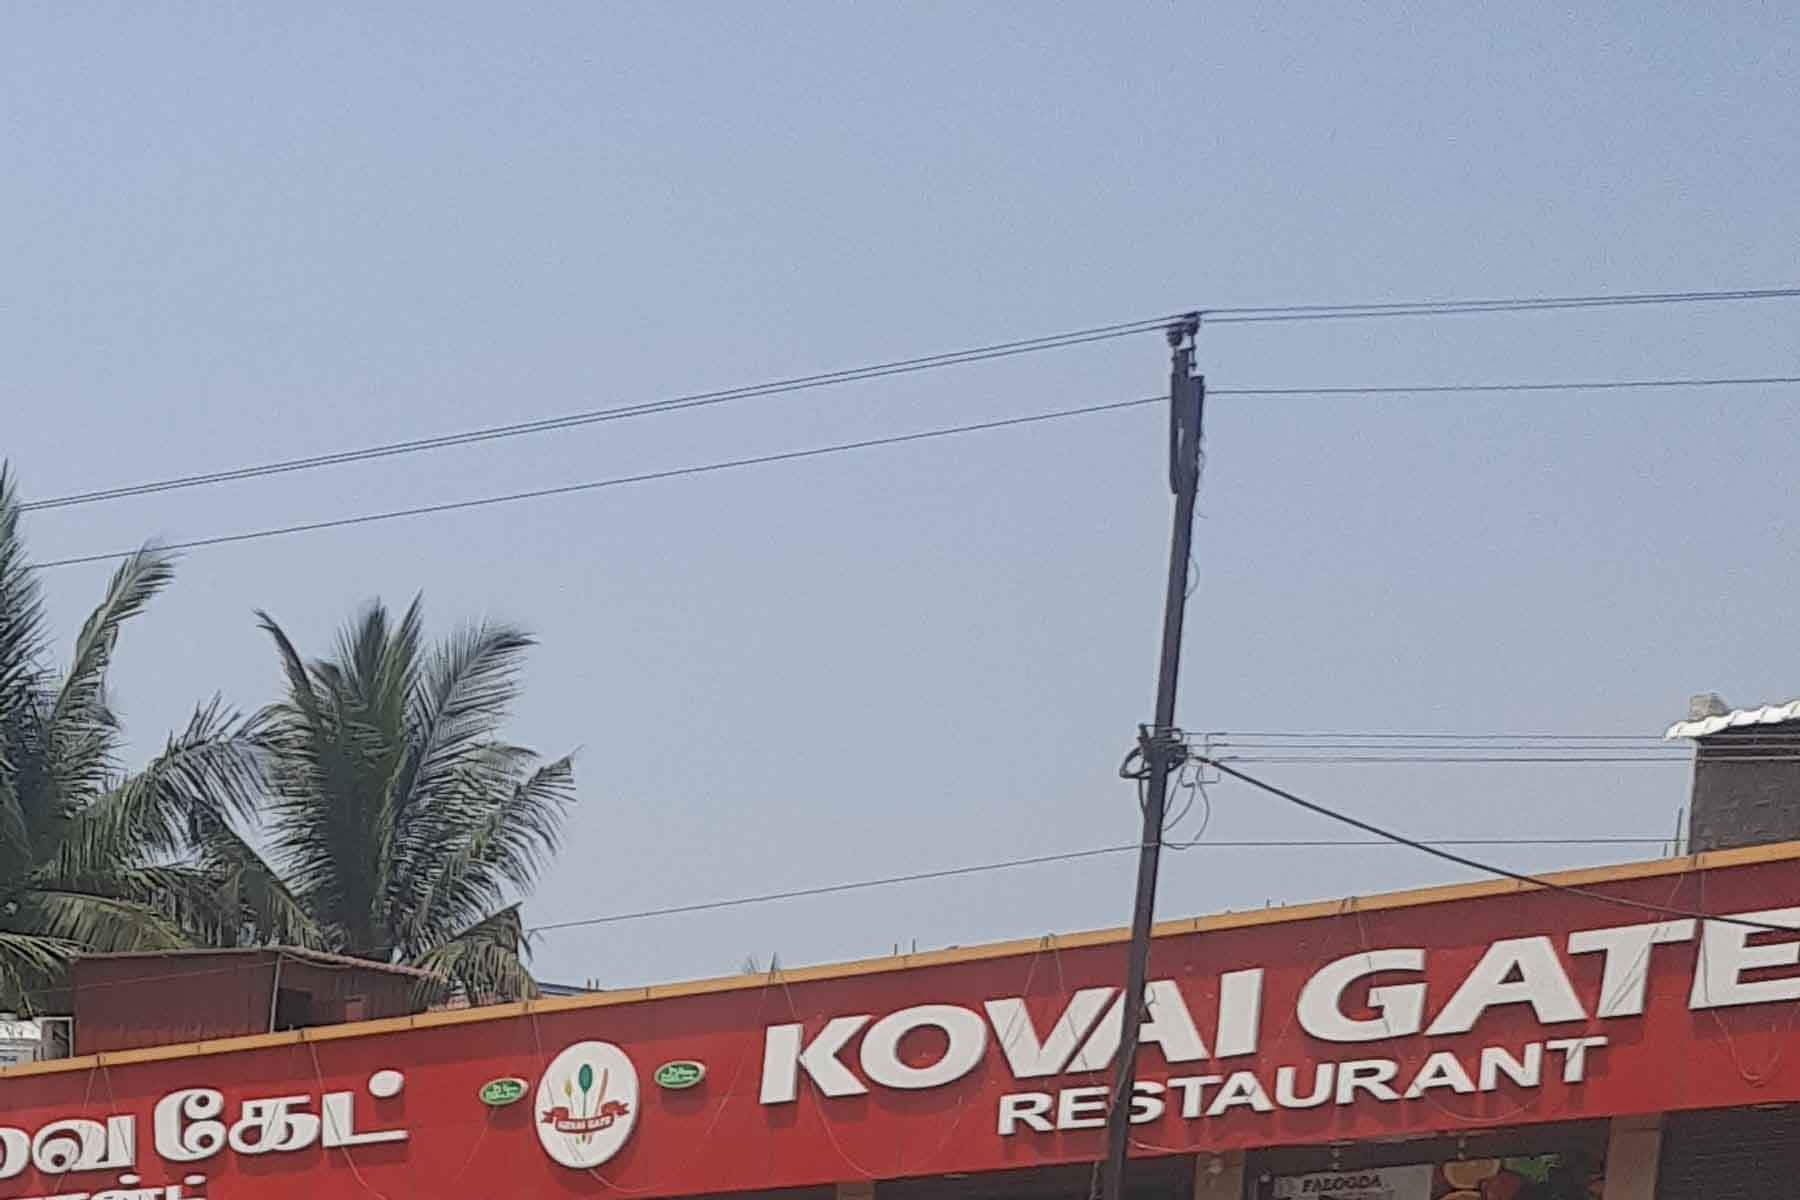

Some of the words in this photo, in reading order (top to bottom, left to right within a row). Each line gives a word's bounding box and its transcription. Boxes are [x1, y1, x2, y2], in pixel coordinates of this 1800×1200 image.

[760, 968, 1263, 1104] KOVAI
[1297, 907, 1800, 1042] GATE
[154, 1070, 408, 1161] கேட்
[998, 1036, 1607, 1135] RESTAURANT
